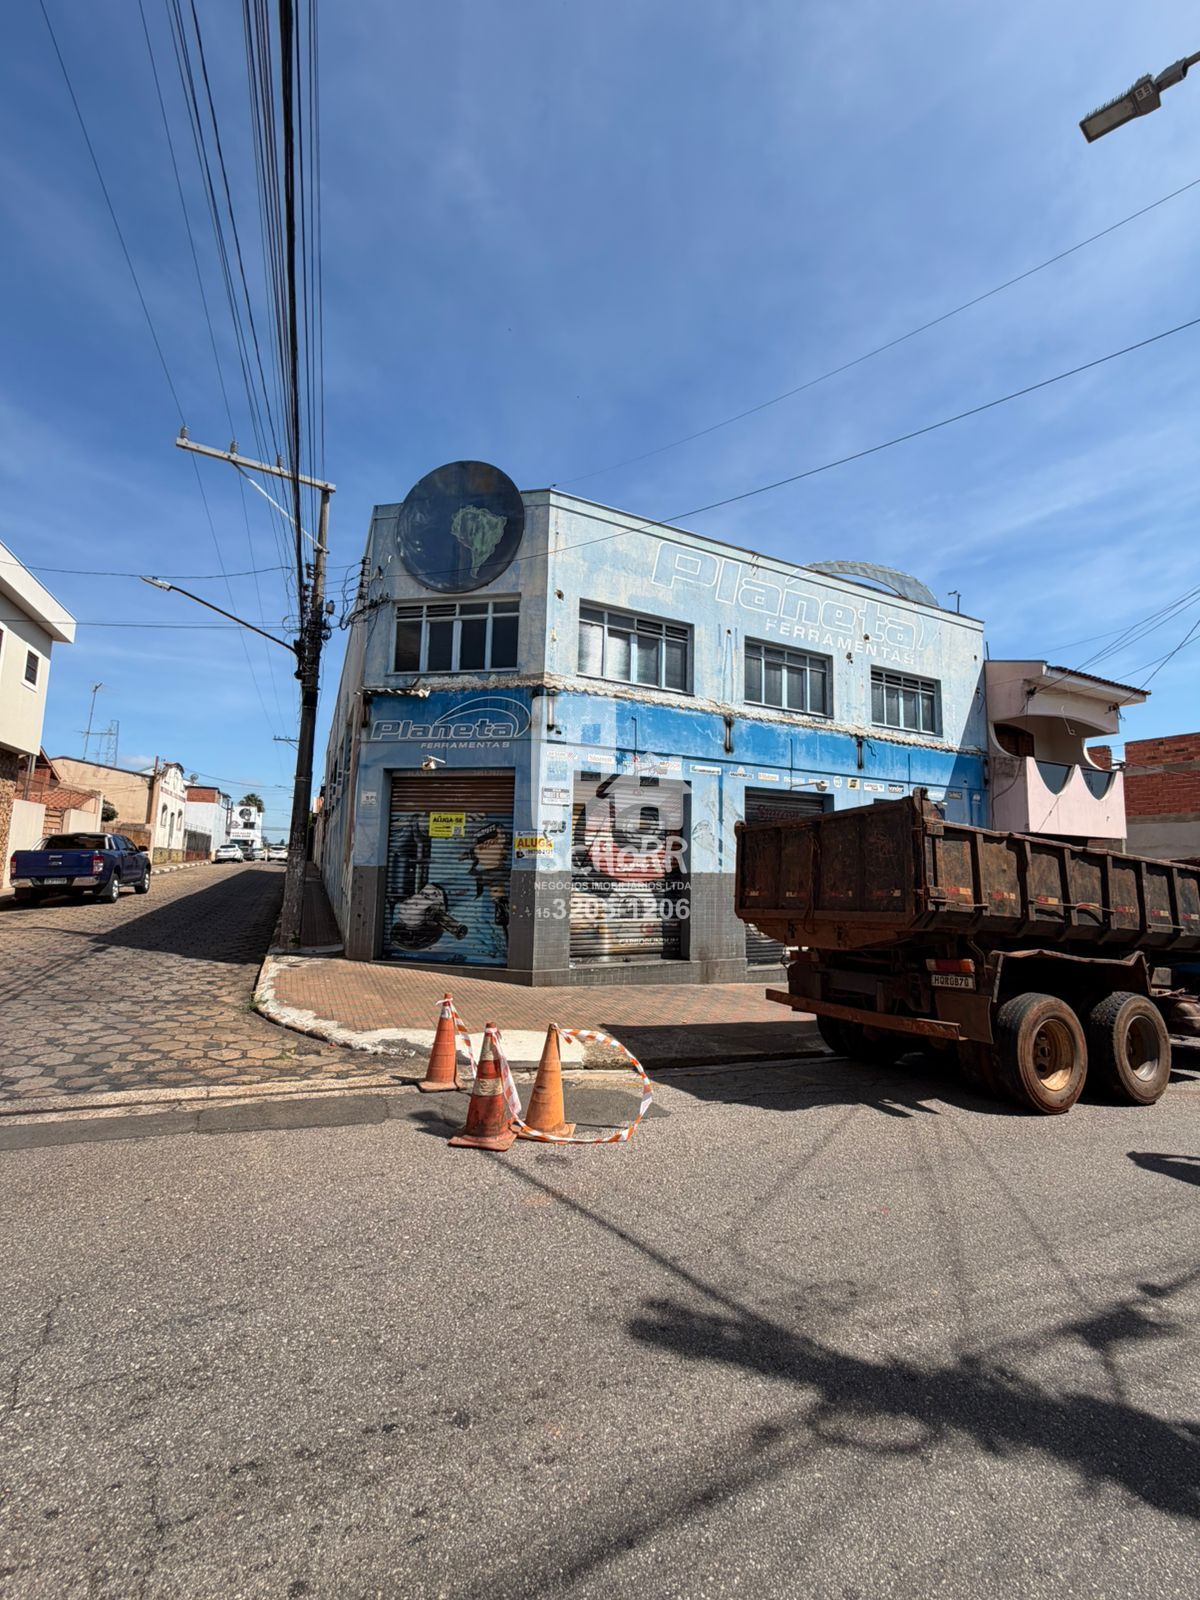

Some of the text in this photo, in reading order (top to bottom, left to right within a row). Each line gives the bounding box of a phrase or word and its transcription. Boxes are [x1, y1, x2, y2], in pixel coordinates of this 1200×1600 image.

[651, 541, 917, 650] Planeta
[765, 618, 915, 665] FERRAMENTAS
[370, 718, 515, 740] Planeta
[420, 741, 511, 749] FERRAMENTAS
